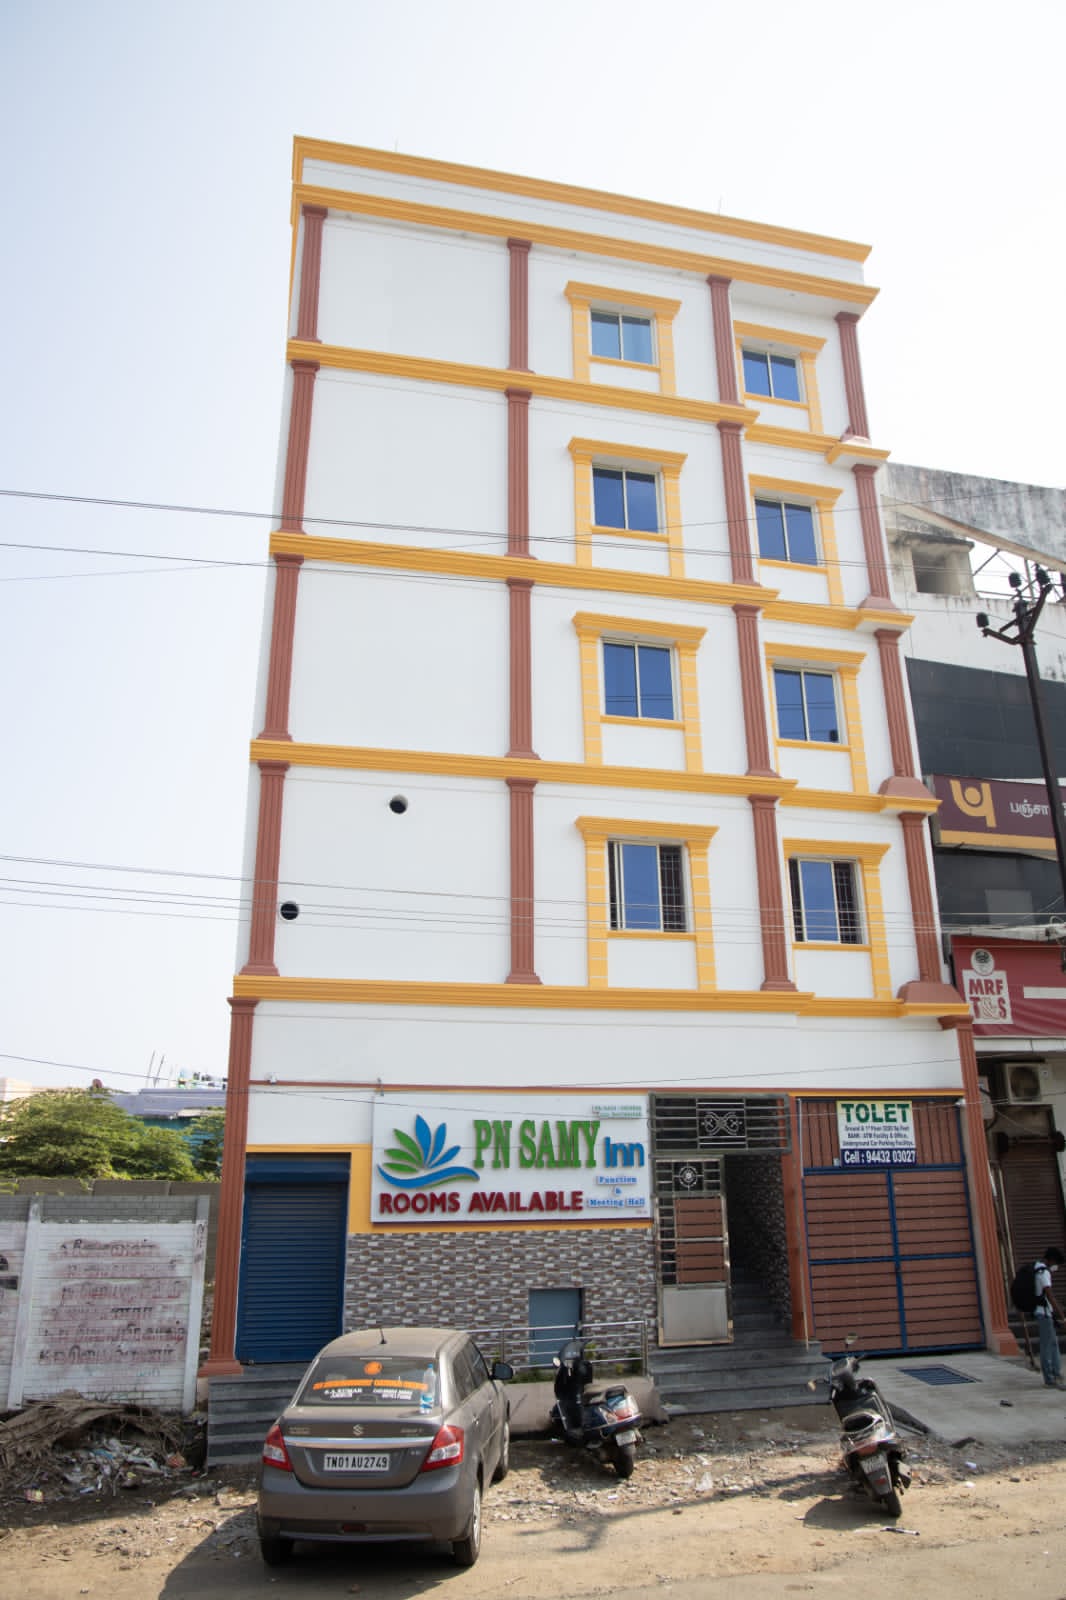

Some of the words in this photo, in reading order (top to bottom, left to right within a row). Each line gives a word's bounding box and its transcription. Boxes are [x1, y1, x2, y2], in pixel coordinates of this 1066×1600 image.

[1009, 799, 1049, 818] பஞ்சா
[968, 979, 1004, 995] MRF
[473, 1119, 512, 1169] PN
[519, 1119, 600, 1169] SAMY
[604, 1136, 645, 1167] Inn
[844, 1150, 860, 1164] Cell
[379, 1192, 461, 1214] ROOMS
[468, 1191, 583, 1213] AVAILABLE
